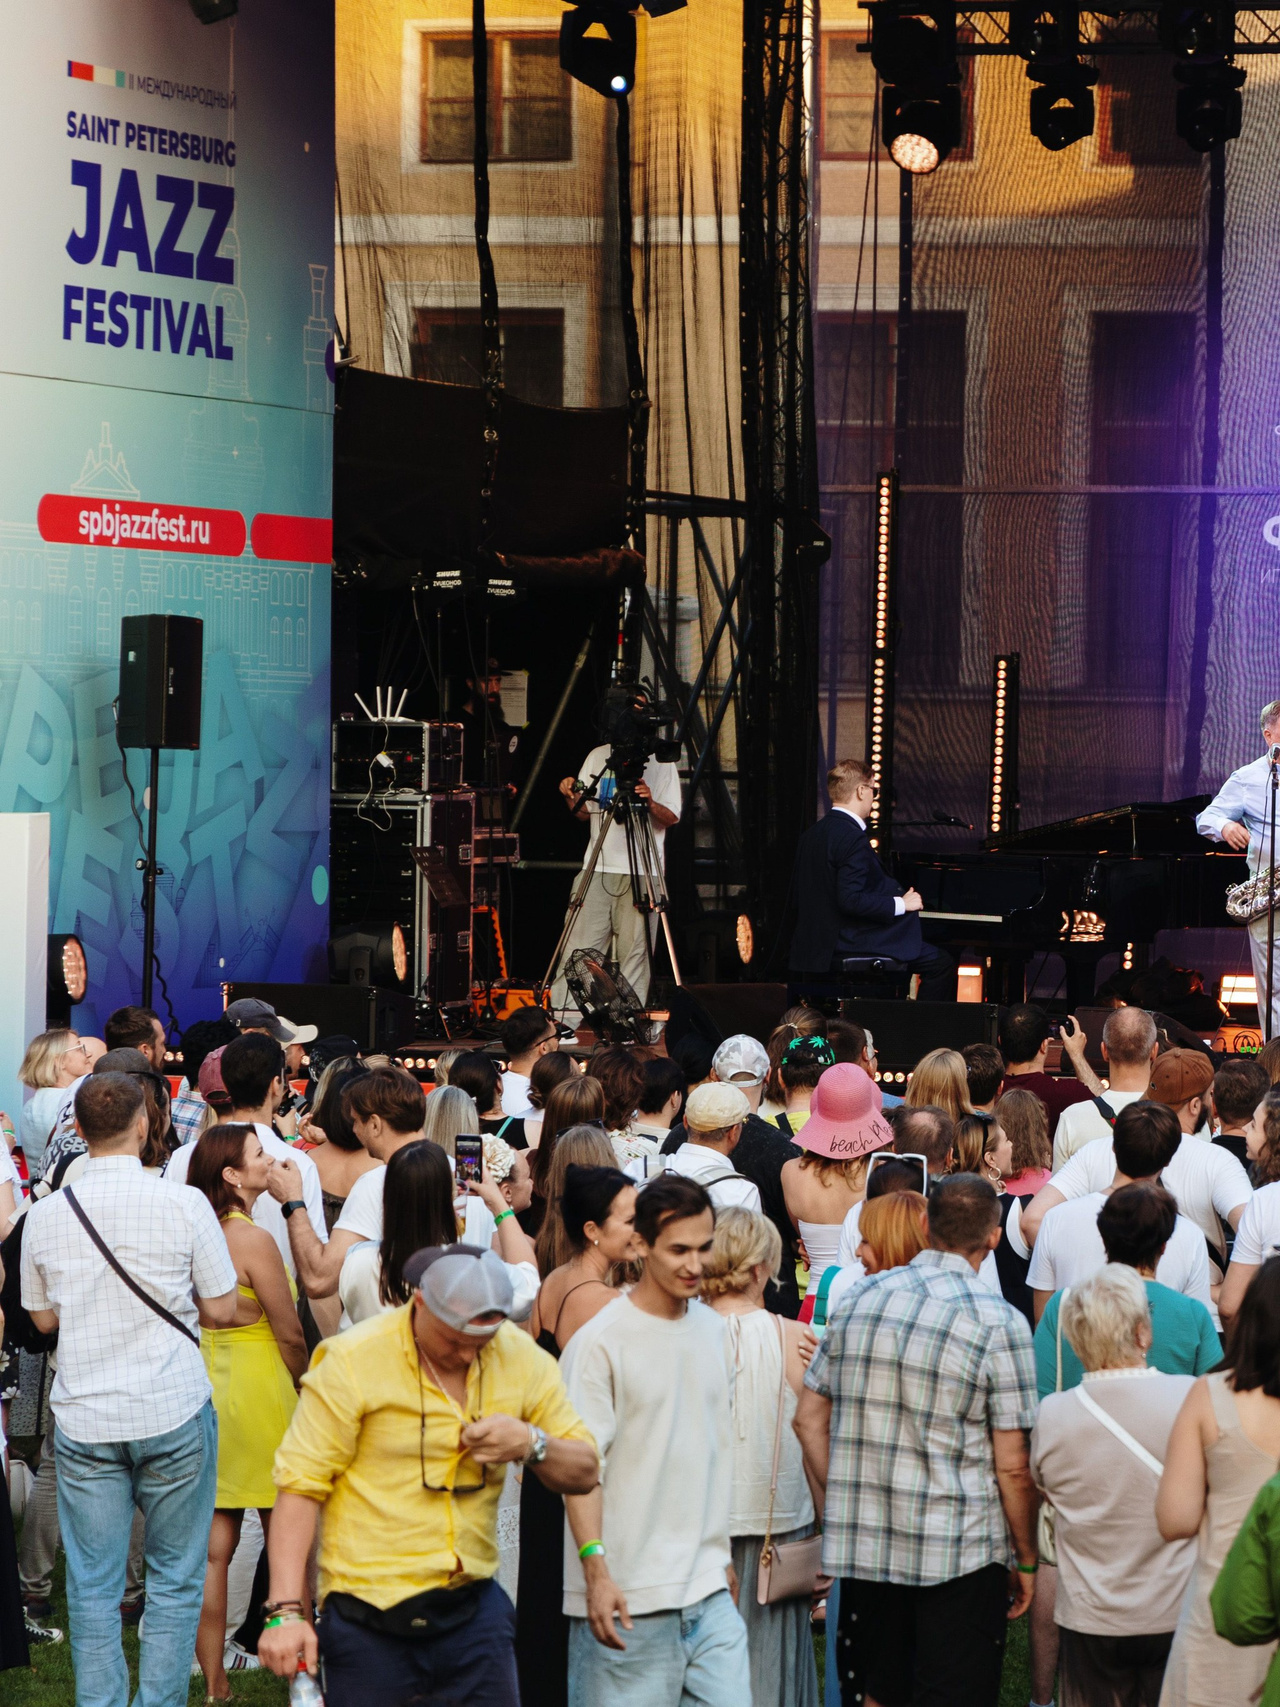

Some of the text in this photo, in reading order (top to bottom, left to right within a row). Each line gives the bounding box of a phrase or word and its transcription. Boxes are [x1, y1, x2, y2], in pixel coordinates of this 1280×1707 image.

[137, 75, 237, 109] МЕЖДУНАРОДНЫЙ
[66, 110, 236, 168] SAINT PETERSBURG
[65, 159, 235, 285] JAZZ
[62, 284, 234, 361] FESTIVAL
[78, 503, 210, 545] spbjazzfest.ru
[829, 1131, 873, 1154] beach
